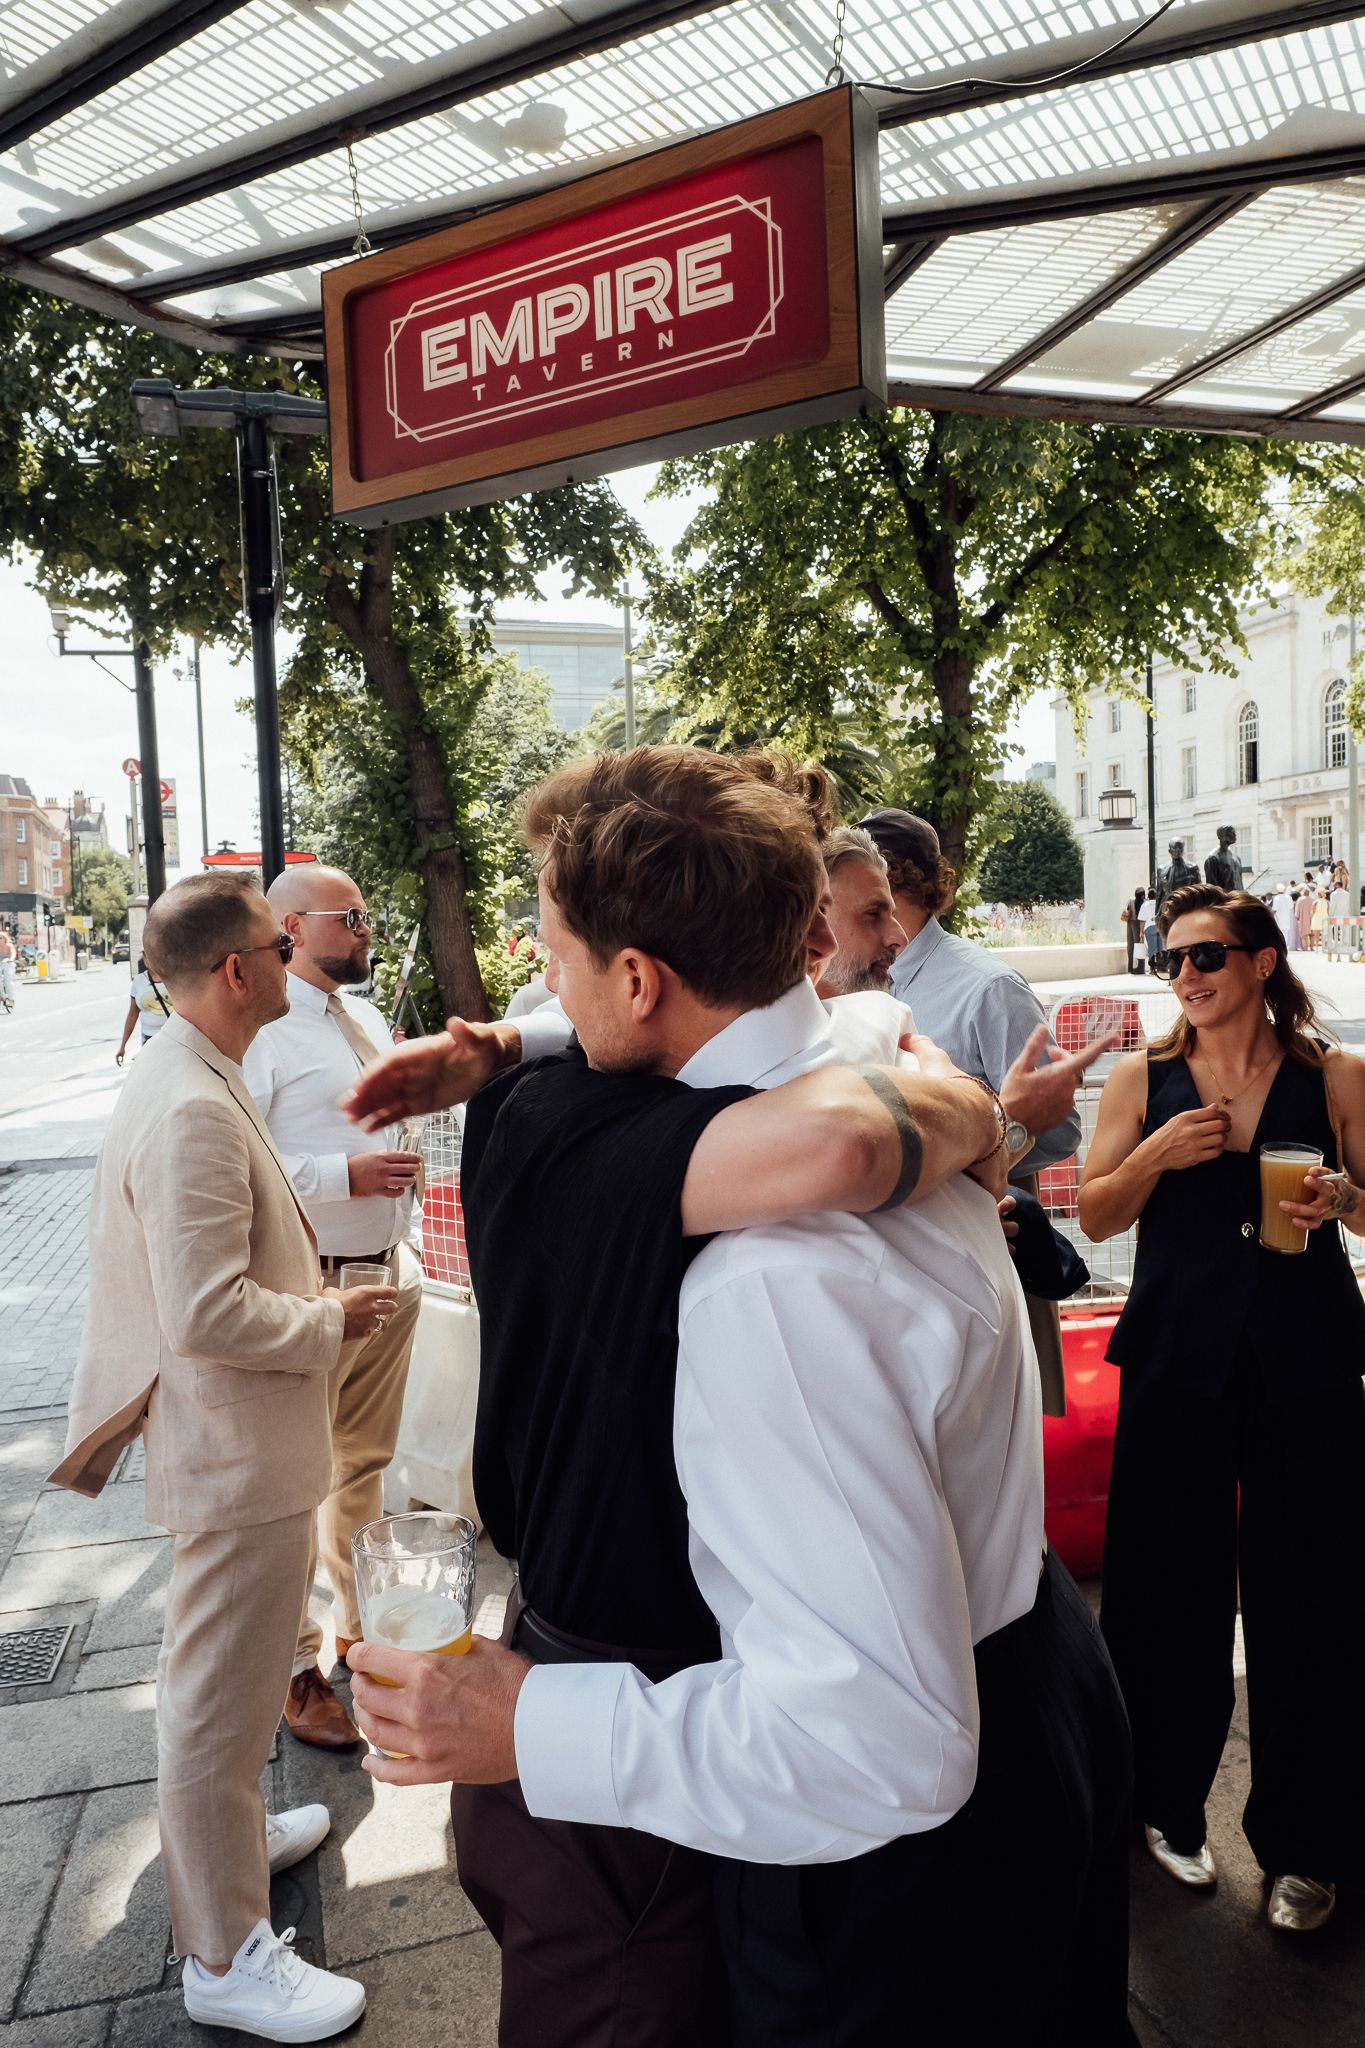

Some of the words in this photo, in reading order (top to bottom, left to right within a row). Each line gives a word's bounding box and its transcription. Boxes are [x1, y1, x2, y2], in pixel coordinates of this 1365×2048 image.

[421, 233, 734, 391] EMPIRE
[472, 329, 674, 402] TAVERN
[125, 759, 140, 775] A
